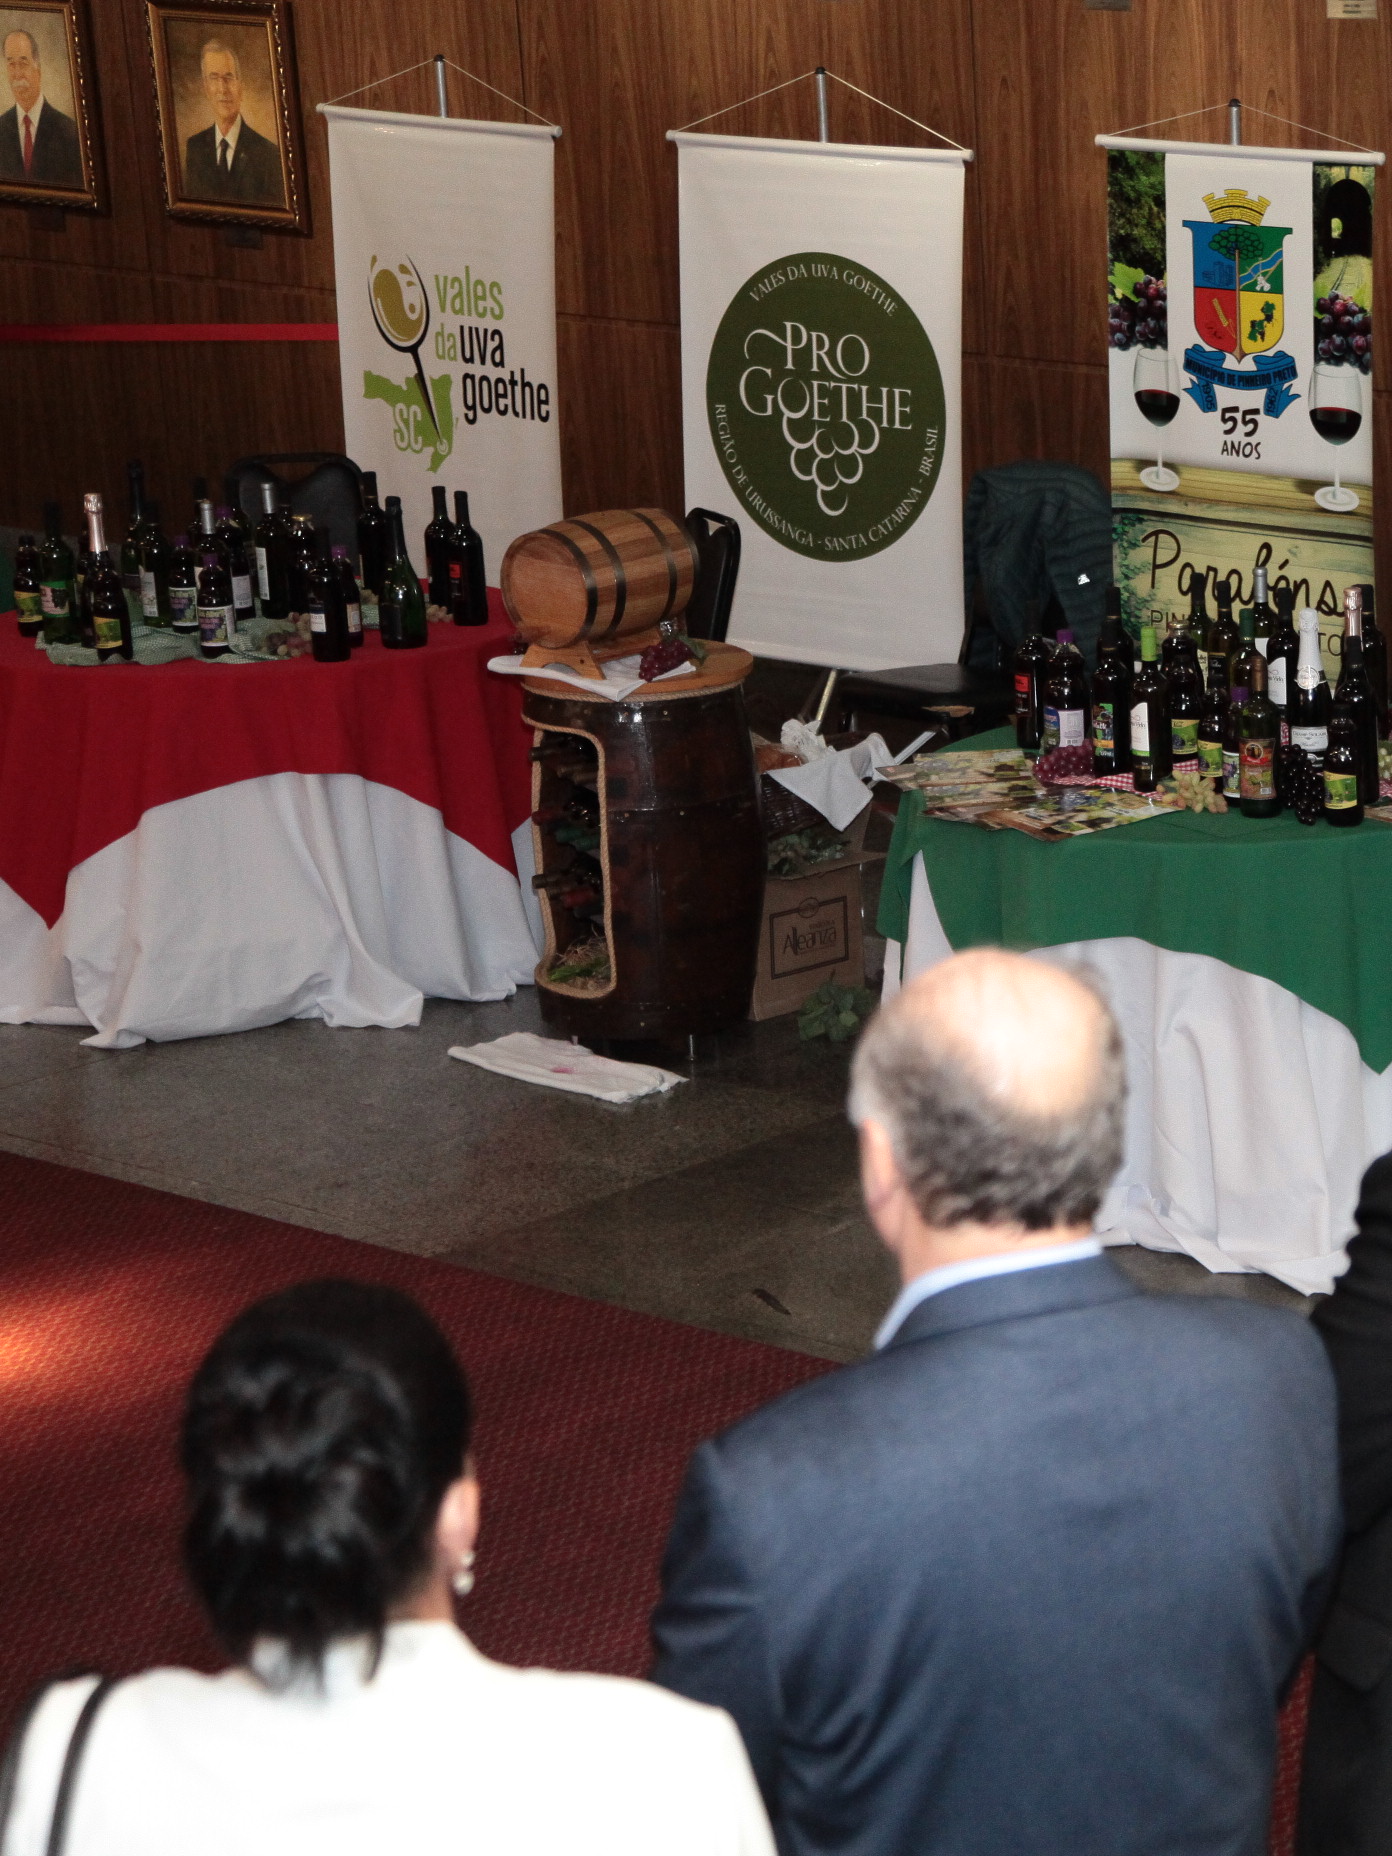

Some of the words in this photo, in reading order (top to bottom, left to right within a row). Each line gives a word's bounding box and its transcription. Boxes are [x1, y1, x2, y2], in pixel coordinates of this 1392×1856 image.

[434, 265, 504, 320] vales
[750, 270, 786, 301] VALES
[787, 264, 806, 279] DA
[811, 263, 839, 279] UVA
[842, 270, 898, 317] GOETHE
[435, 323, 457, 361] da
[460, 325, 505, 368] uva
[744, 322, 870, 379] PRO
[462, 368, 550, 425] goethe
[739, 366, 912, 430] GOETHE
[1220, 406, 1261, 437] 55
[393, 402, 424, 454] SC
[1221, 440, 1261, 460] ANOS
[714, 404, 737, 463] REGIÃO
[732, 464, 746, 488] DE
[745, 485, 814, 547] URUSSANGA
[824, 533, 868, 551] SANTA
[868, 486, 922, 543] CATARINA
[919, 425, 939, 477] BRASIL
